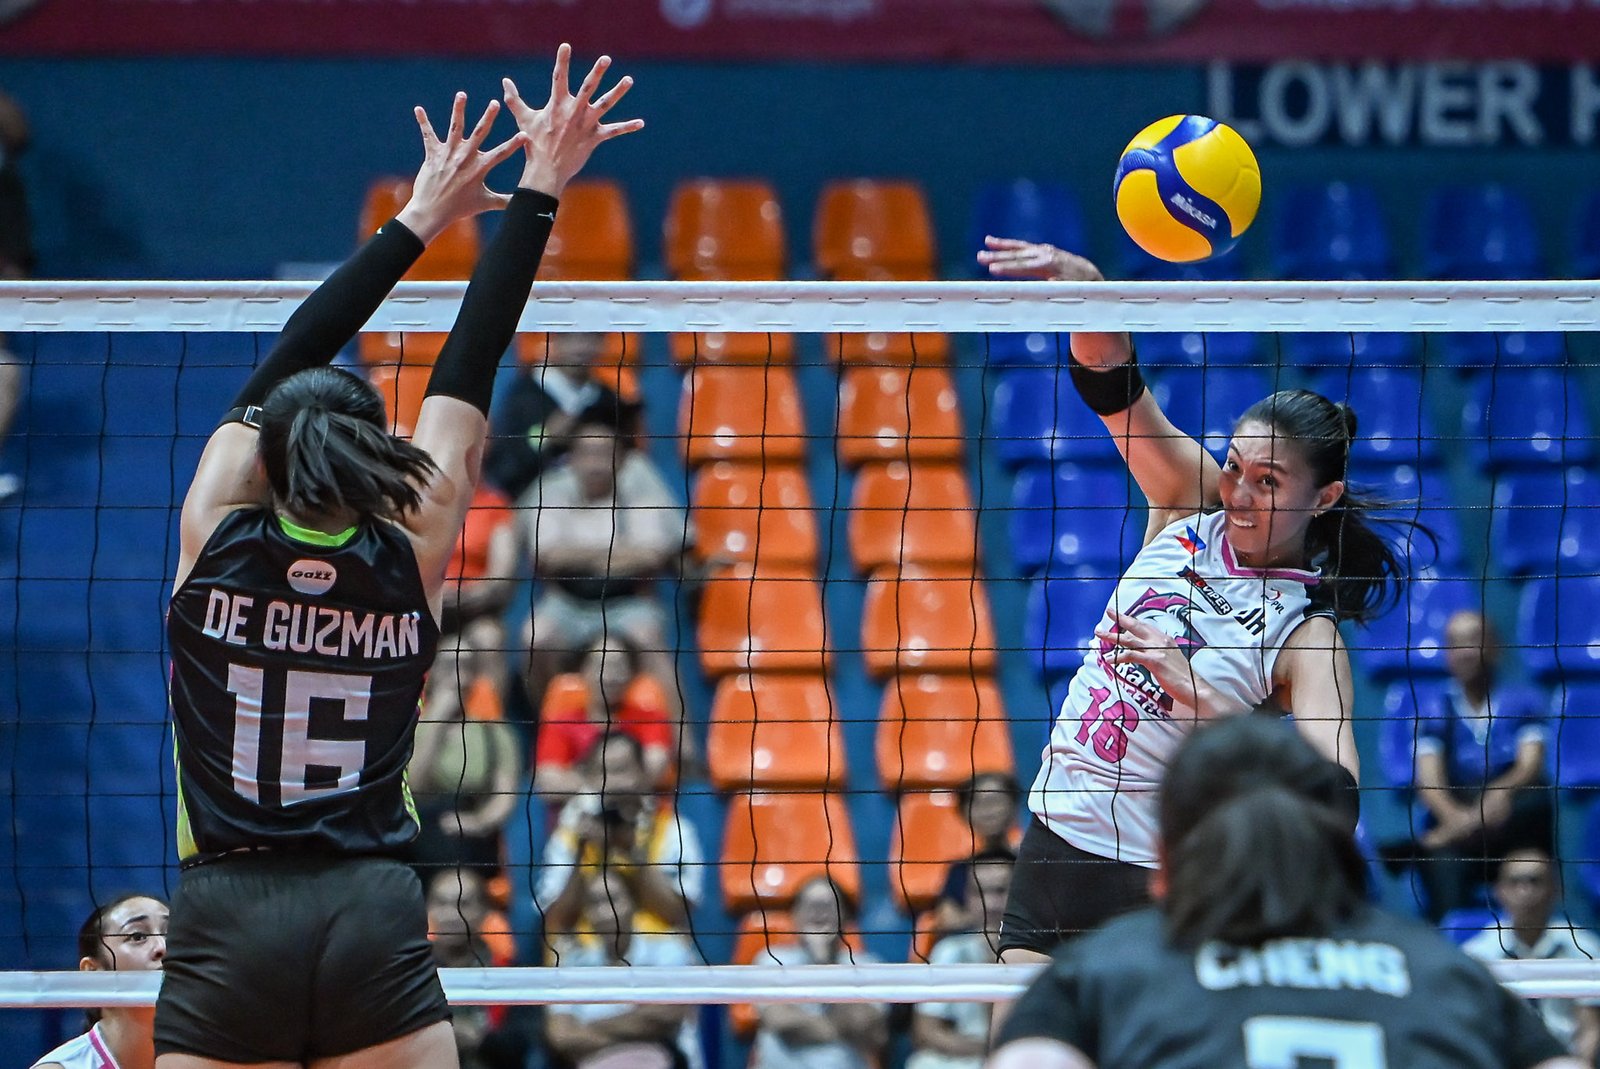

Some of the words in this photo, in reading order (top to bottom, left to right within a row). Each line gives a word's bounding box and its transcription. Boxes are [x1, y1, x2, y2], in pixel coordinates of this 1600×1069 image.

[1207, 58, 1544, 147] LOWER
[202, 588, 254, 646] DE
[262, 600, 421, 659] GUZMAN
[226, 662, 373, 808] 16
[1074, 686, 1139, 764] 16
